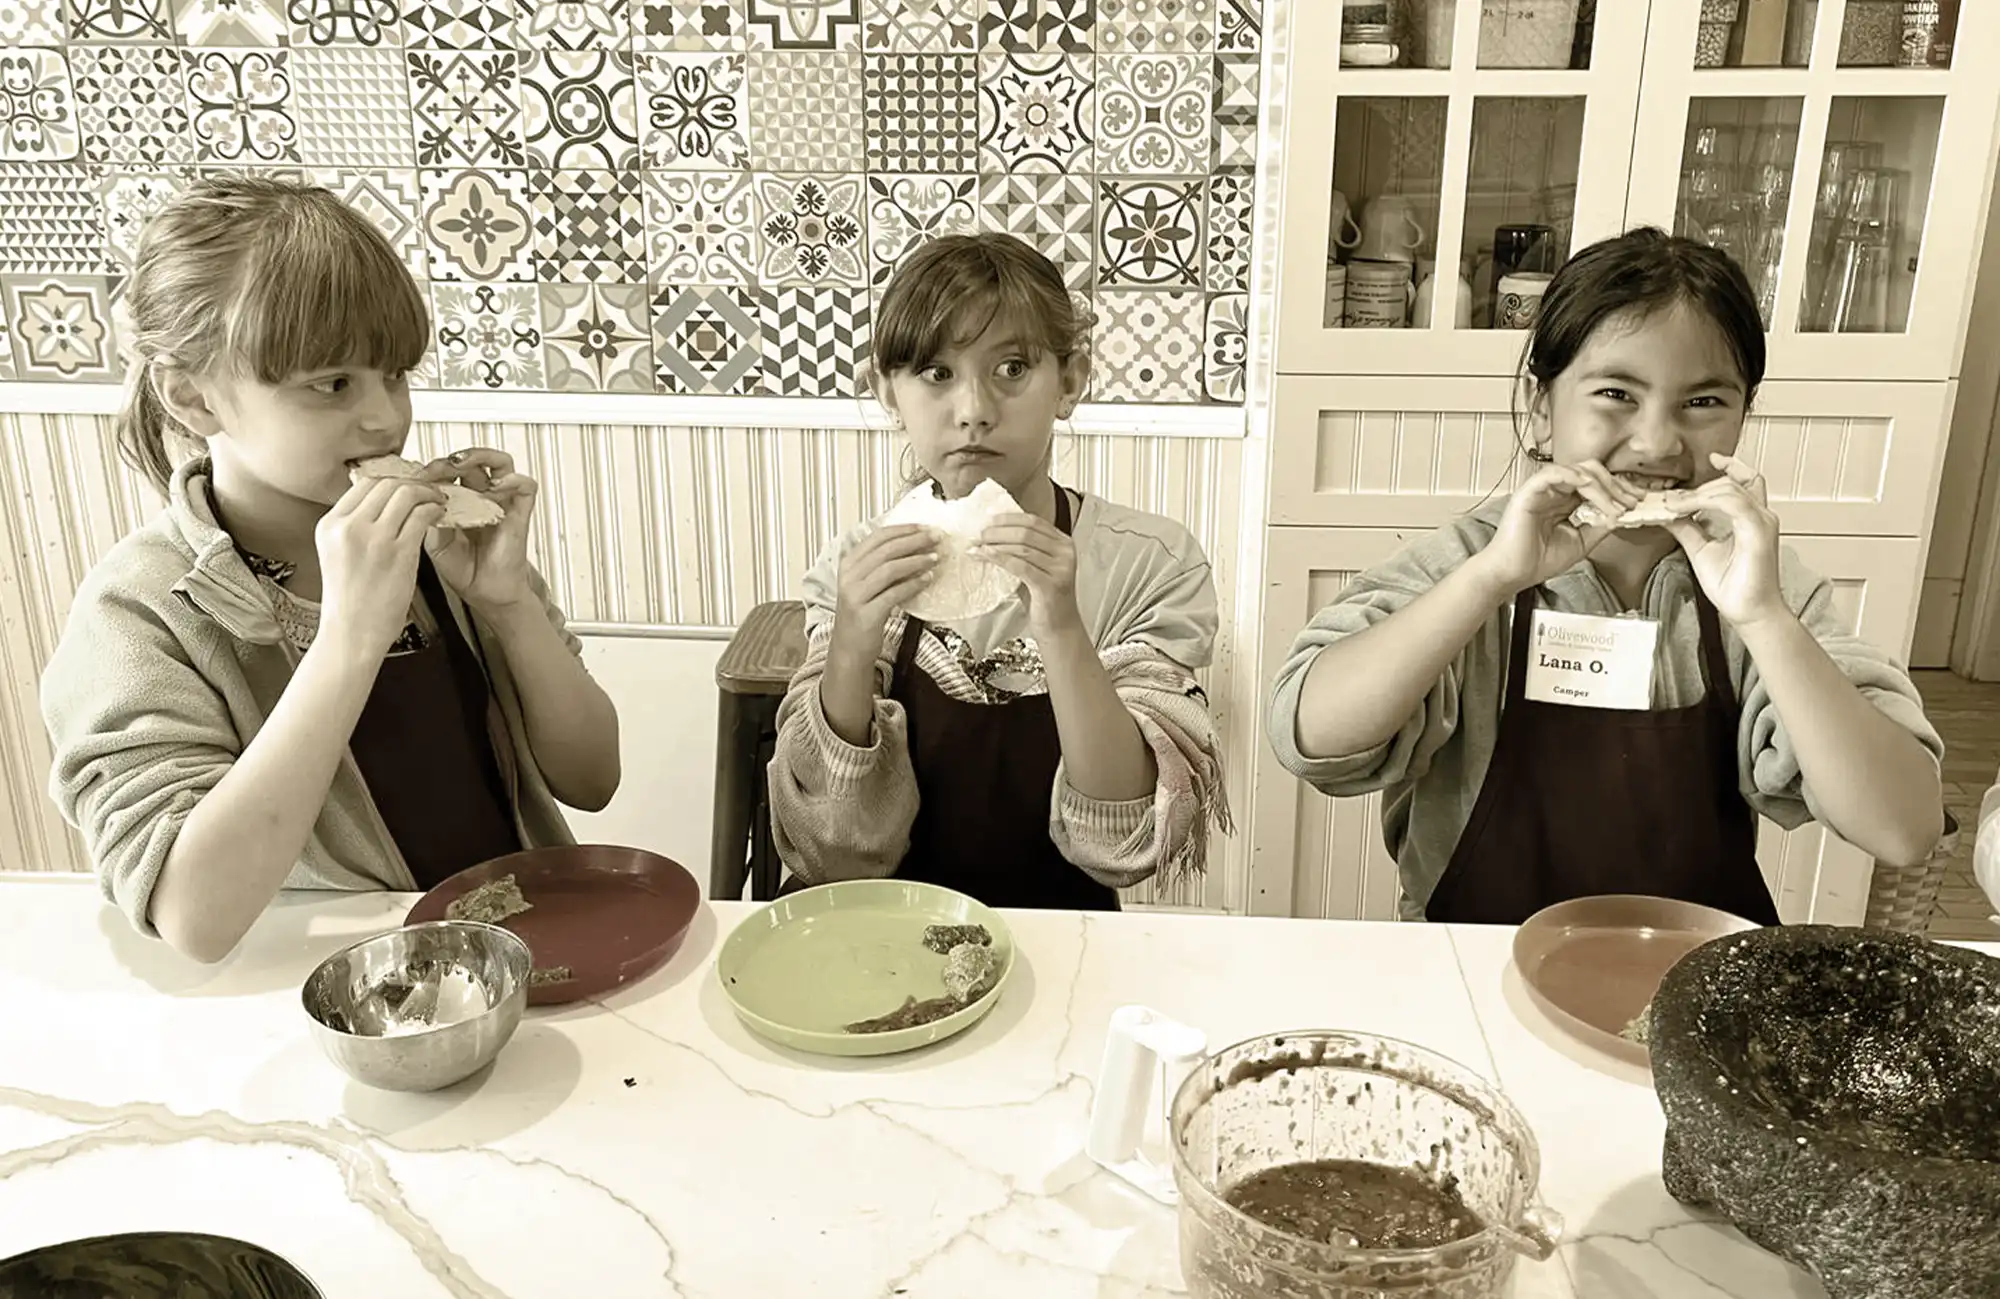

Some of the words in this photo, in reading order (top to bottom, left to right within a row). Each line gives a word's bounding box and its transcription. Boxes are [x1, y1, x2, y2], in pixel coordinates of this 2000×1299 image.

[1904, 2, 1938, 13] BAKING
[1548, 626, 1614, 645] Olivewood
[1539, 653, 1583, 671] Lana
[1589, 660, 1609, 675] O.
[1553, 686, 1590, 698] Camper
